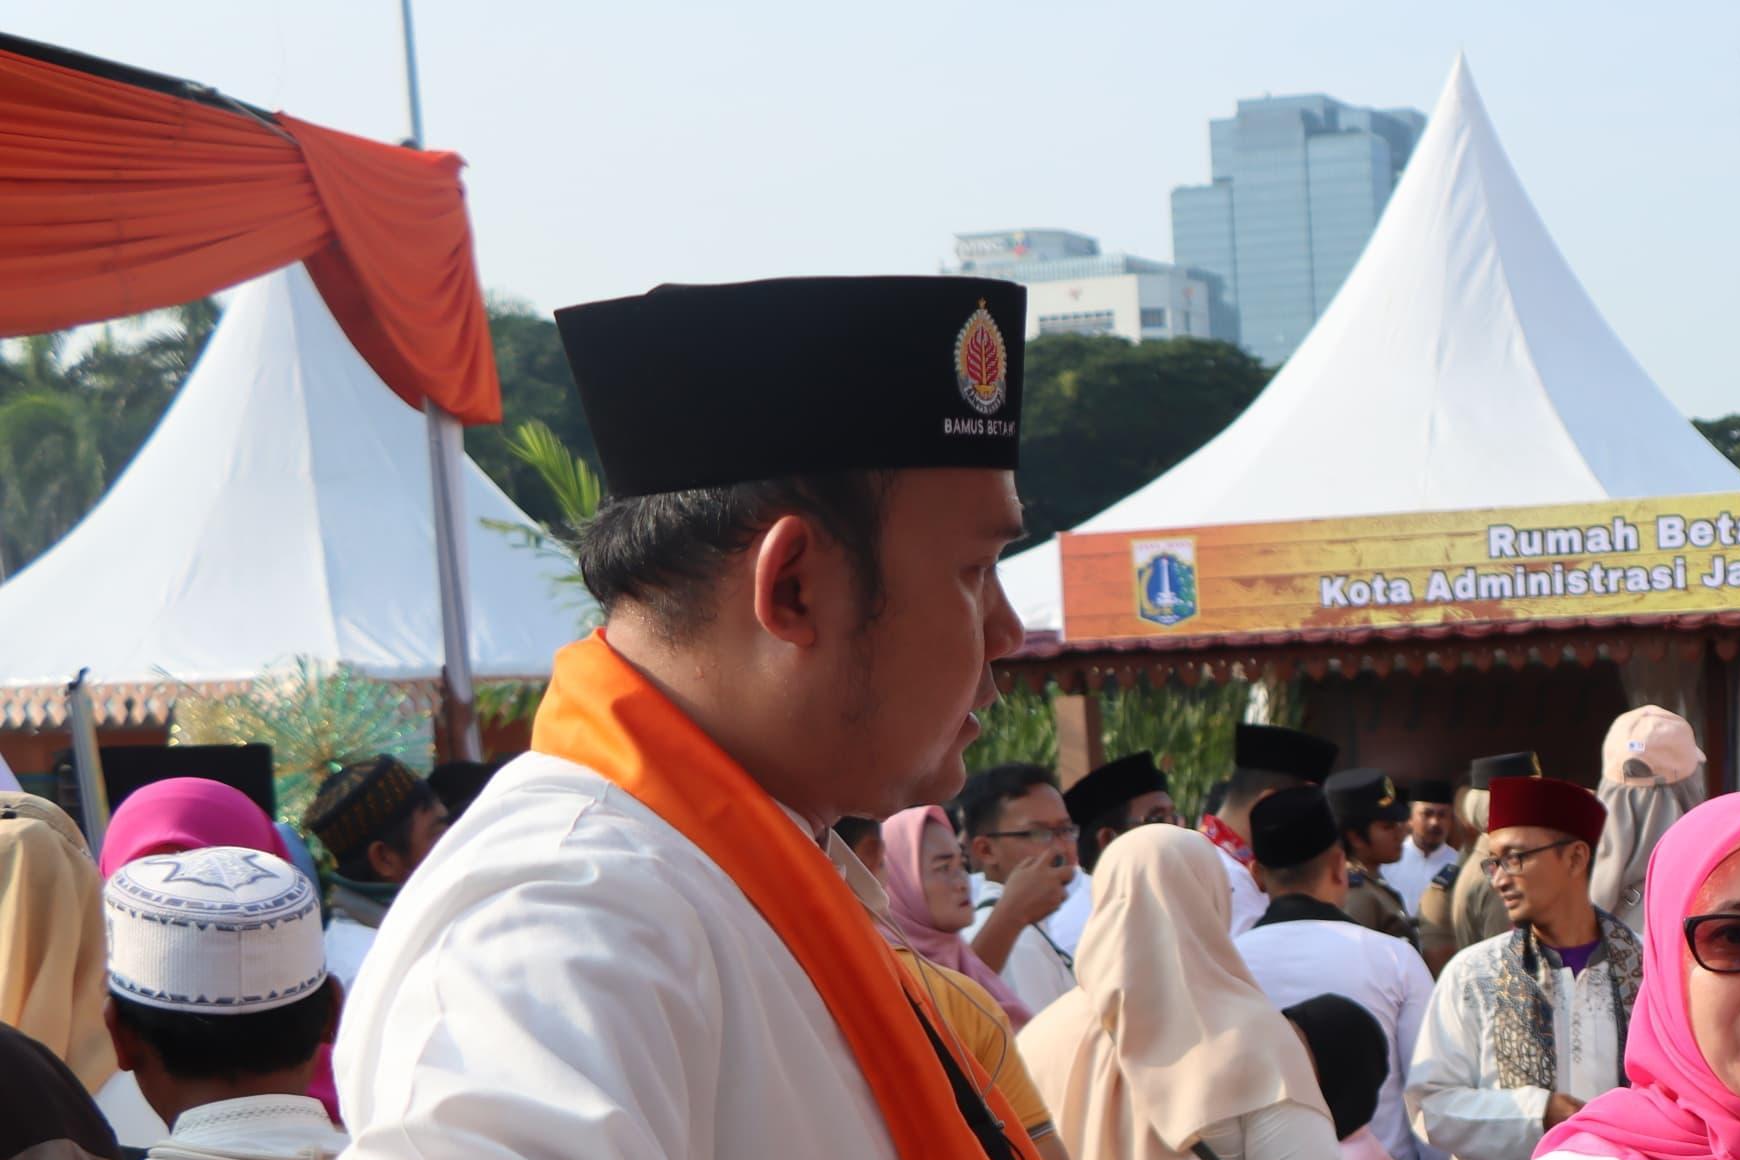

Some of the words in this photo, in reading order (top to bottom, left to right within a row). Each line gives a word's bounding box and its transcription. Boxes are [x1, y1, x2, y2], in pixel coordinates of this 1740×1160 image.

[944, 417, 984, 435] BAMUS
[1487, 516, 1640, 559] Rumah
[1319, 571, 1415, 609] Kota
[1424, 554, 1687, 602] Administrasi
